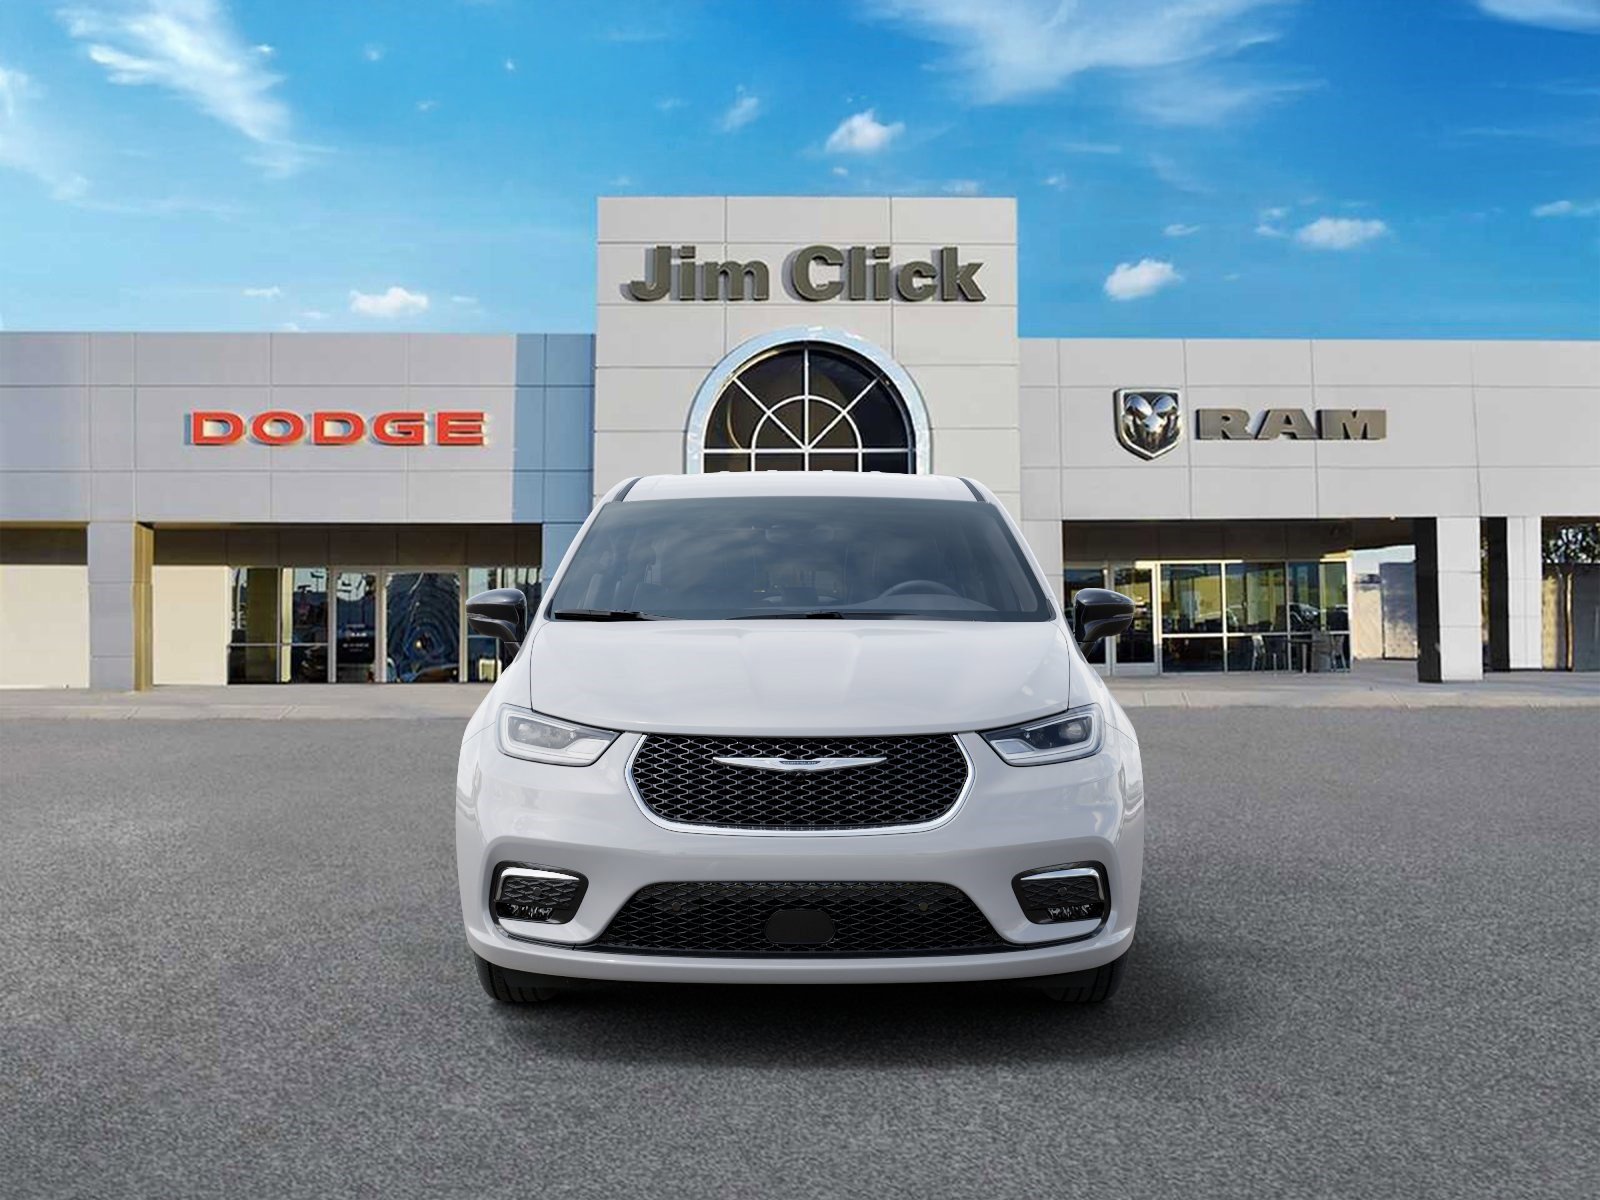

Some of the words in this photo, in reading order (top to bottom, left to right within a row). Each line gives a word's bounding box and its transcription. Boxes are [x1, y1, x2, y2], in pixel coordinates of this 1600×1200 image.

[627, 245, 770, 302] Jim
[791, 244, 987, 302] Click
[190, 411, 486, 446] DODGE
[1196, 408, 1387, 440] RAM
